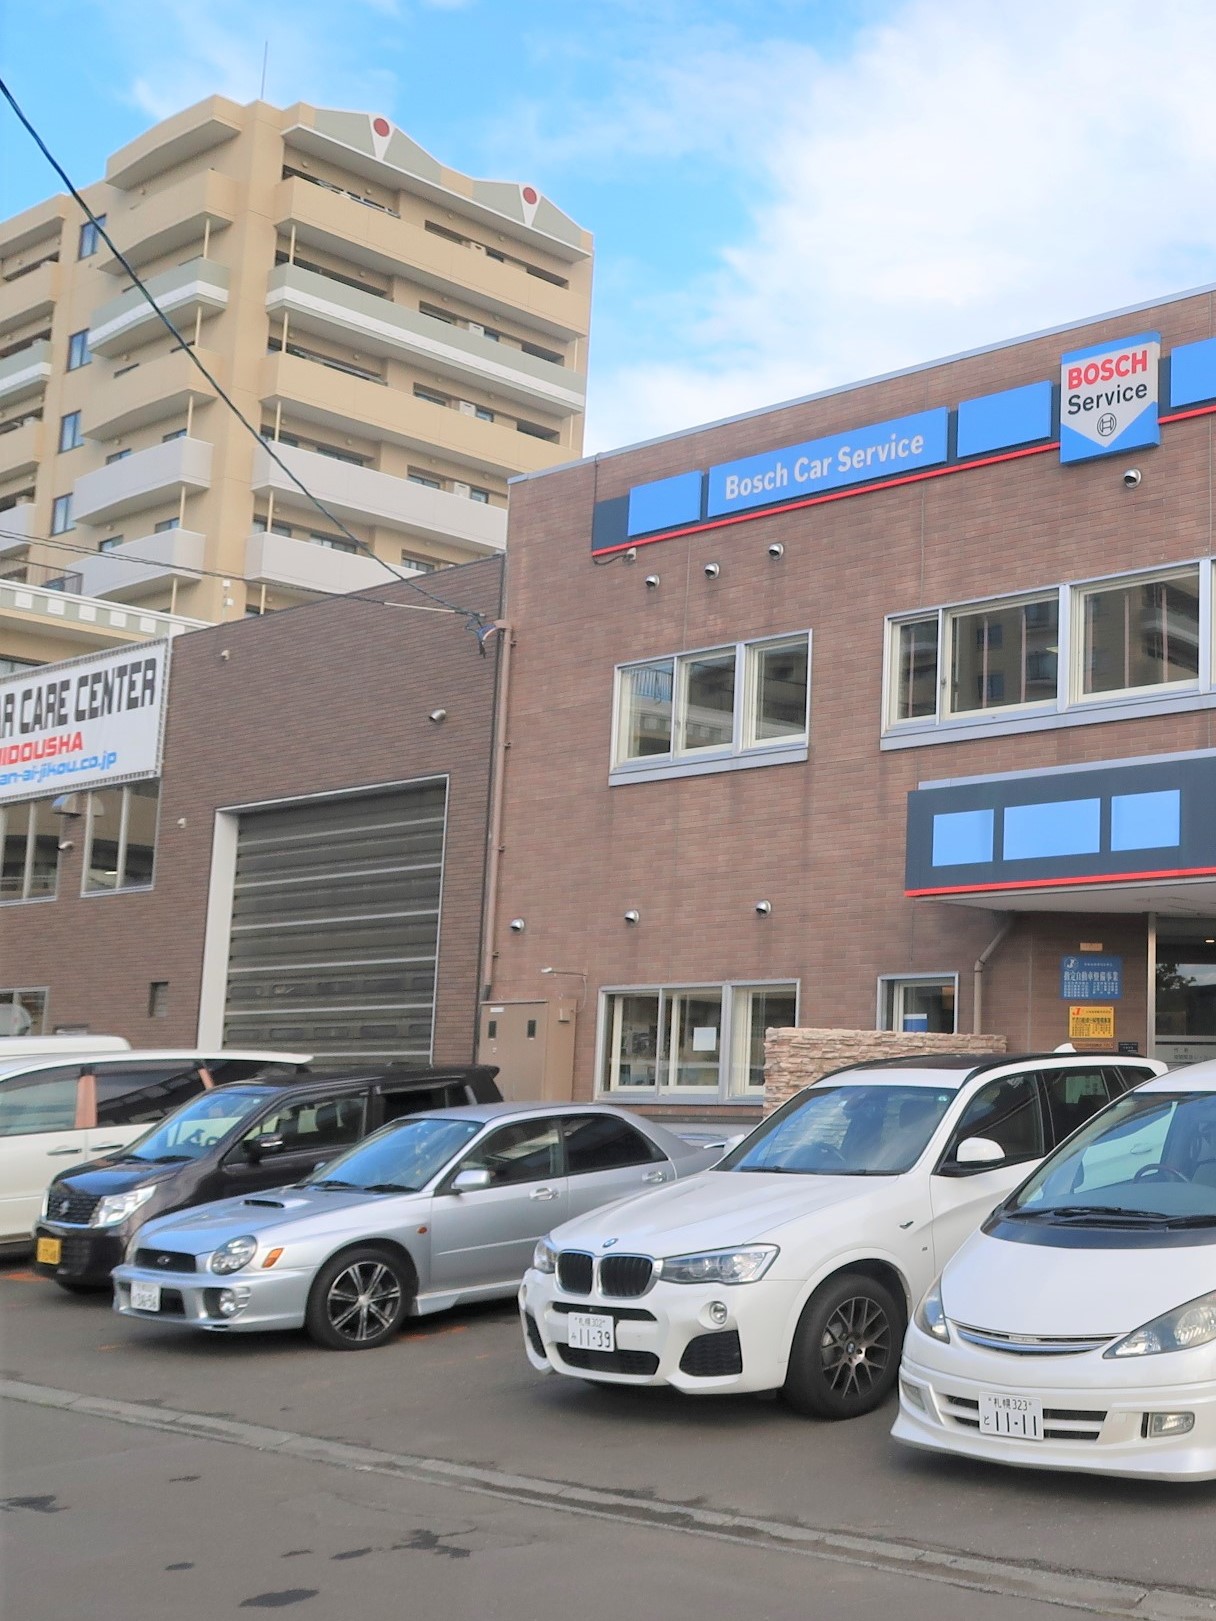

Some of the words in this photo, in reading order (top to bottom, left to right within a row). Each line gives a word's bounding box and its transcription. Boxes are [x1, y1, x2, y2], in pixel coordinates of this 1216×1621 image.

[1068, 350, 1148, 390] BOSCH
[1067, 384, 1148, 415] Service
[725, 462, 788, 500] Bosch
[794, 456, 833, 483] Car
[837, 433, 925, 472] Service
[19, 678, 71, 734] CARE
[74, 658, 157, 722] CENTER
